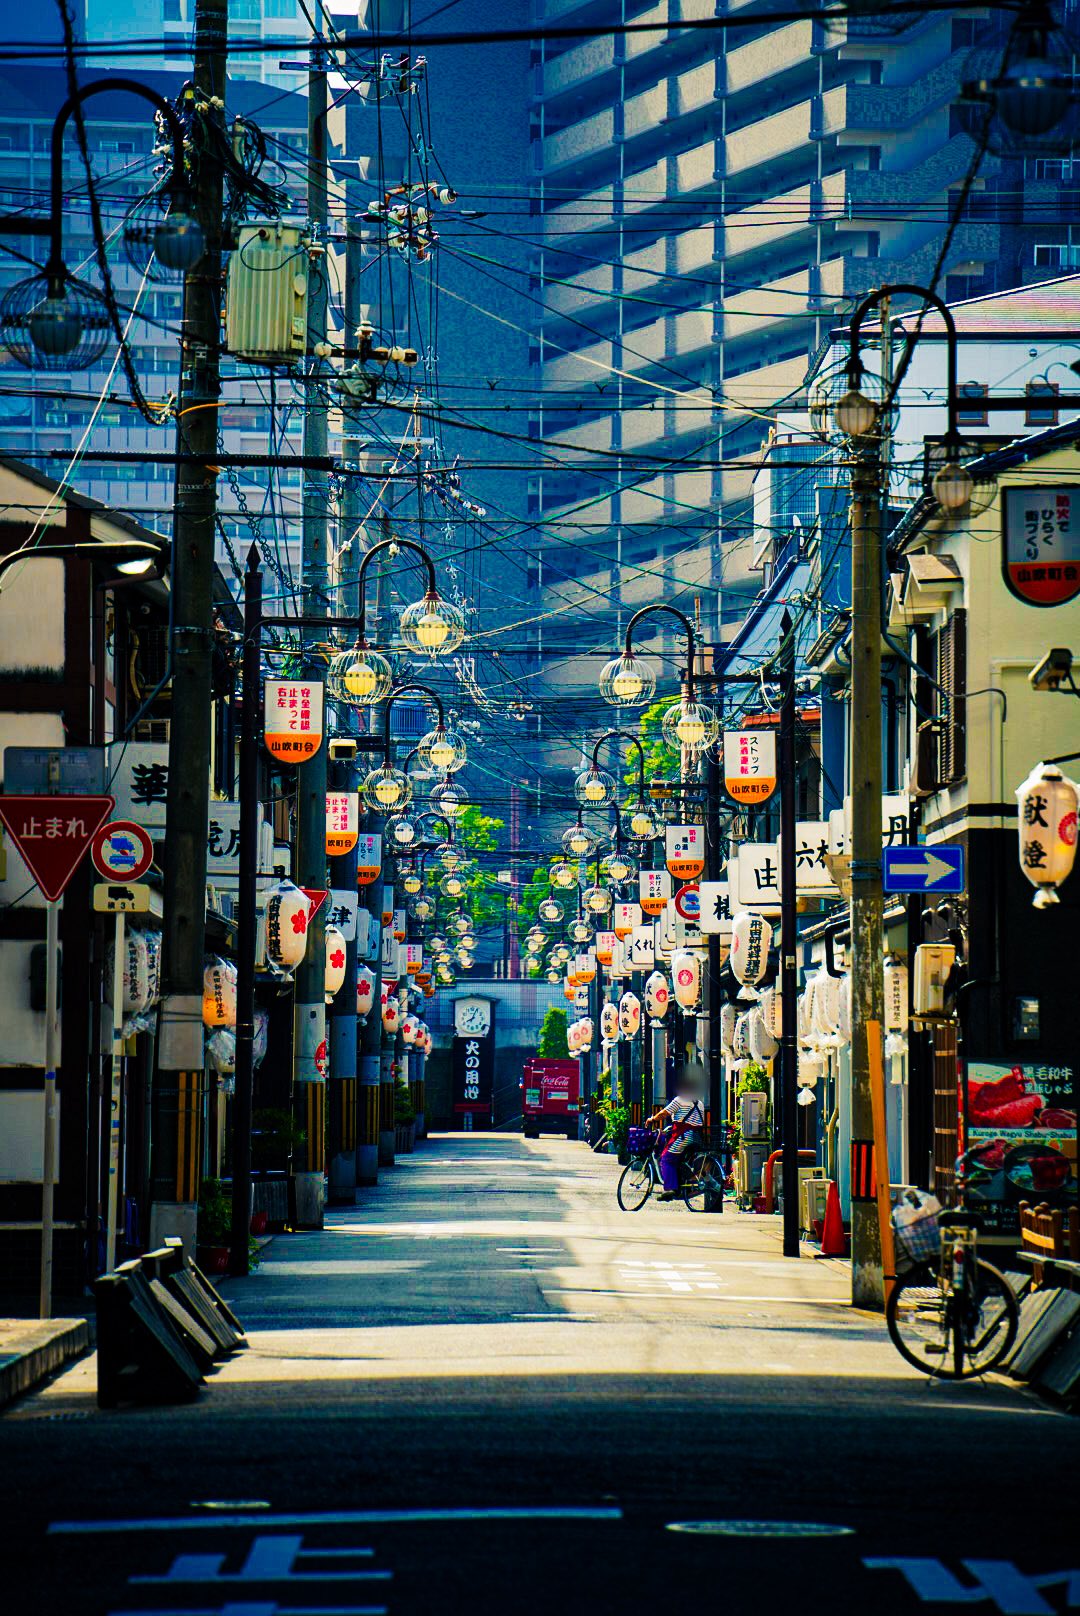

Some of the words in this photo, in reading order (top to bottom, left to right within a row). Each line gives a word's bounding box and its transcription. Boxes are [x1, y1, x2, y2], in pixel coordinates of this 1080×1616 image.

[1041, 509, 1055, 545] ひらく
[276, 687, 287, 708] 右左
[288, 688, 298, 731] 止まって
[300, 688, 311, 731] 安全確認
[271, 741, 314, 753] 山吹町会
[749, 736, 760, 775] ストップ
[731, 784, 770, 795] 山吹町会
[19, 816, 90, 839] 止まれ
